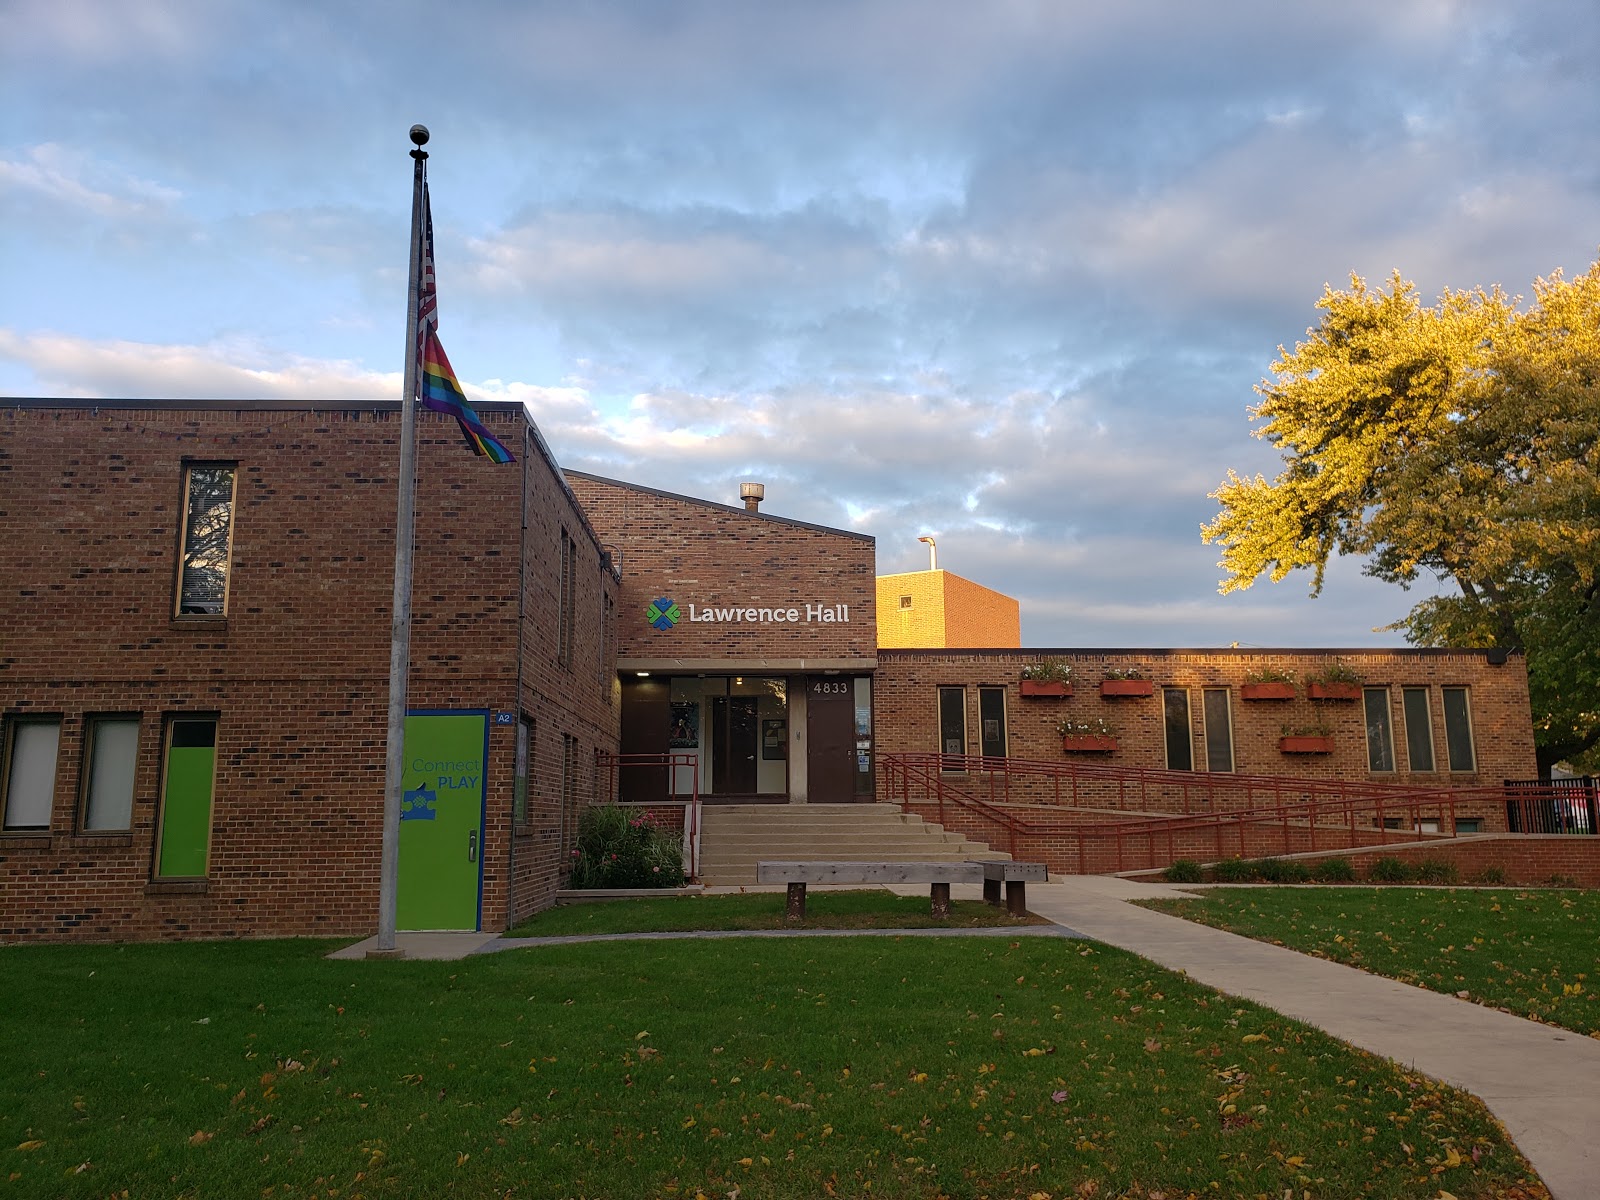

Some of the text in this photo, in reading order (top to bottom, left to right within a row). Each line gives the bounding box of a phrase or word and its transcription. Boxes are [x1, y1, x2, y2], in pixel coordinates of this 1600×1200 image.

[688, 603, 850, 623] Lawrence Hall
[813, 683, 848, 694] 4833
[498, 714, 510, 722] A2
[412, 758, 480, 772] Connect
[438, 776, 478, 789] PLAY
